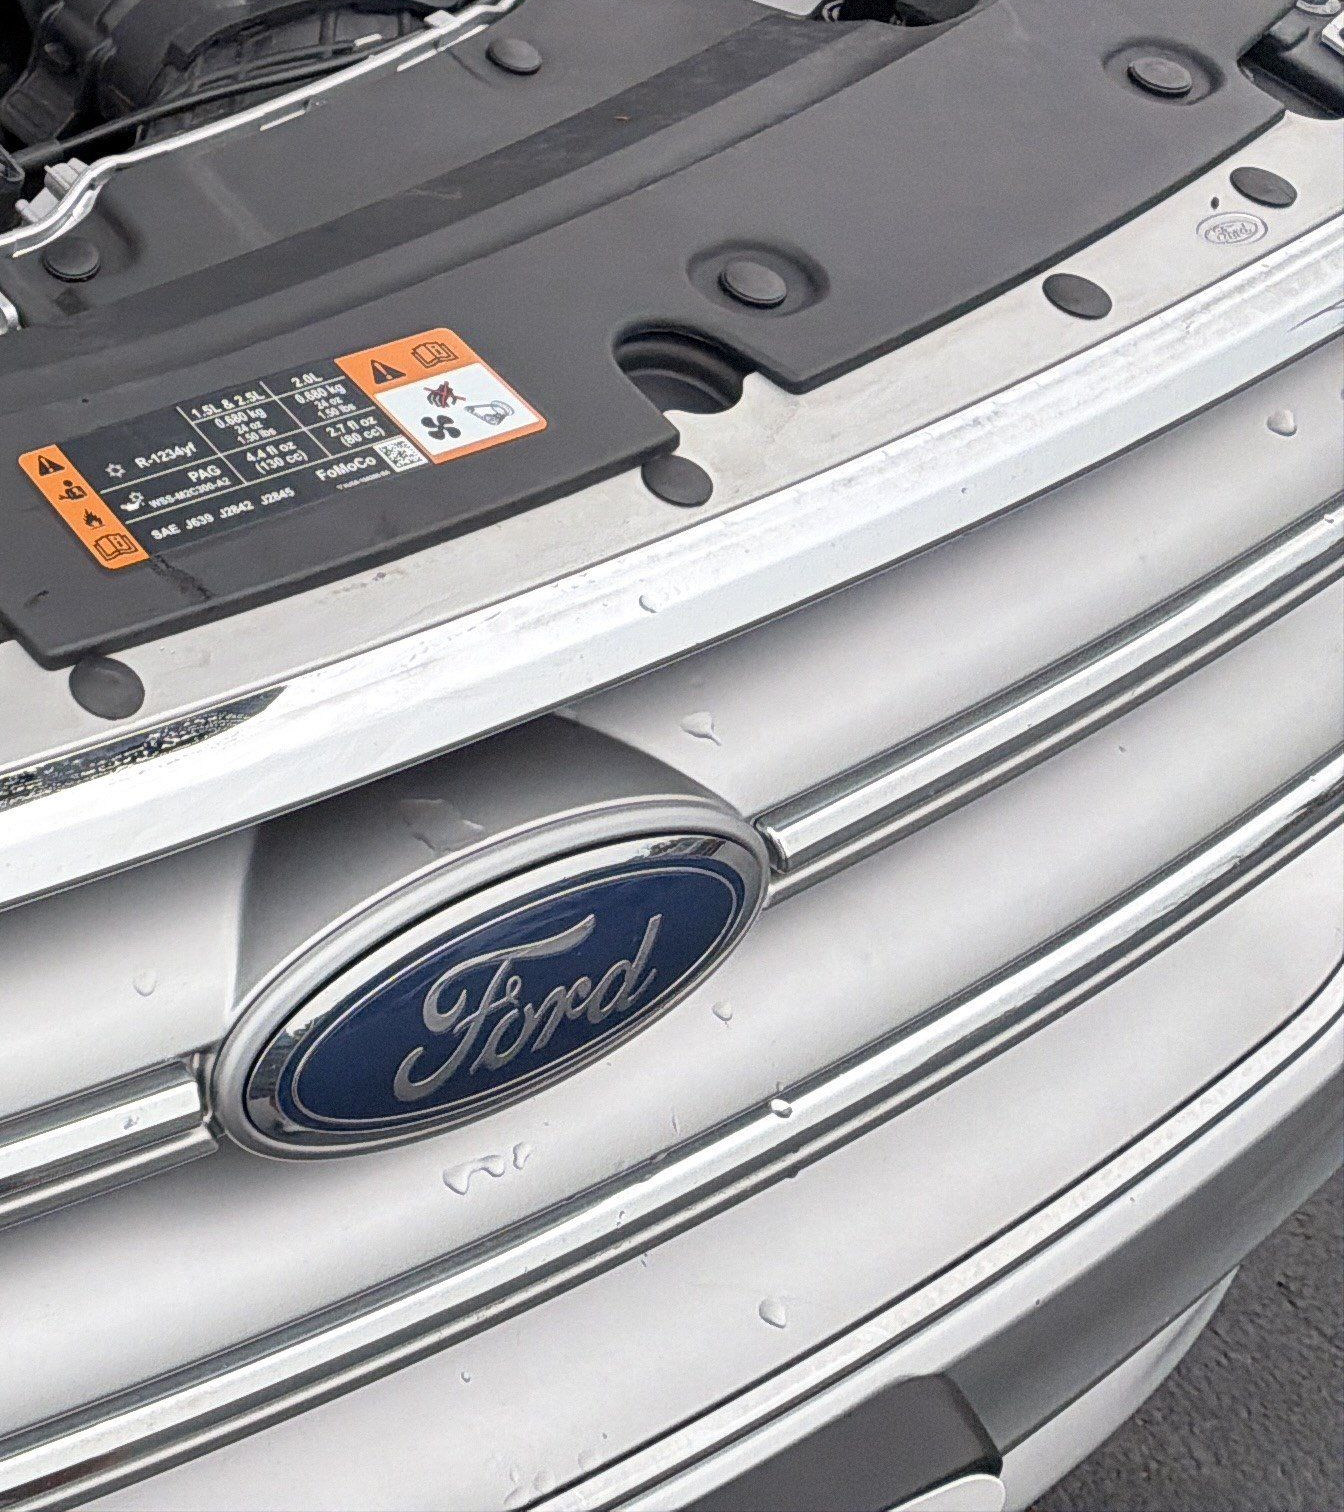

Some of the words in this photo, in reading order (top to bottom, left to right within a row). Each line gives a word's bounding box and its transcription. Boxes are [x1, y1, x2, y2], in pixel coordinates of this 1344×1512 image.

[291, 373, 323, 388] 2.0L
[324, 383, 347, 395] kg
[191, 403, 222, 419] 1.5L
[221, 399, 235, 411] &
[233, 390, 266, 406] 2.5L
[314, 399, 330, 410] 24
[215, 410, 249, 429] 0.680
[245, 407, 268, 419] kg
[234, 424, 250, 435] 24
[248, 420, 264, 431] oz
[325, 423, 346, 438] 2.7
[359, 416, 378, 427] oz
[340, 432, 363, 448] (80
[363, 425, 386, 438] cc)
[134, 441, 197, 470] R-1234yf
[246, 448, 268, 462] 4.4
[280, 441, 297, 452] oz
[255, 455, 285, 474] (130
[285, 449, 309, 464] cc)
[187, 464, 222, 483] PAG
[315, 456, 377, 481] FoMoCo
[151, 523, 181, 540] SAE
[393, 912, 663, 1103] Ford
